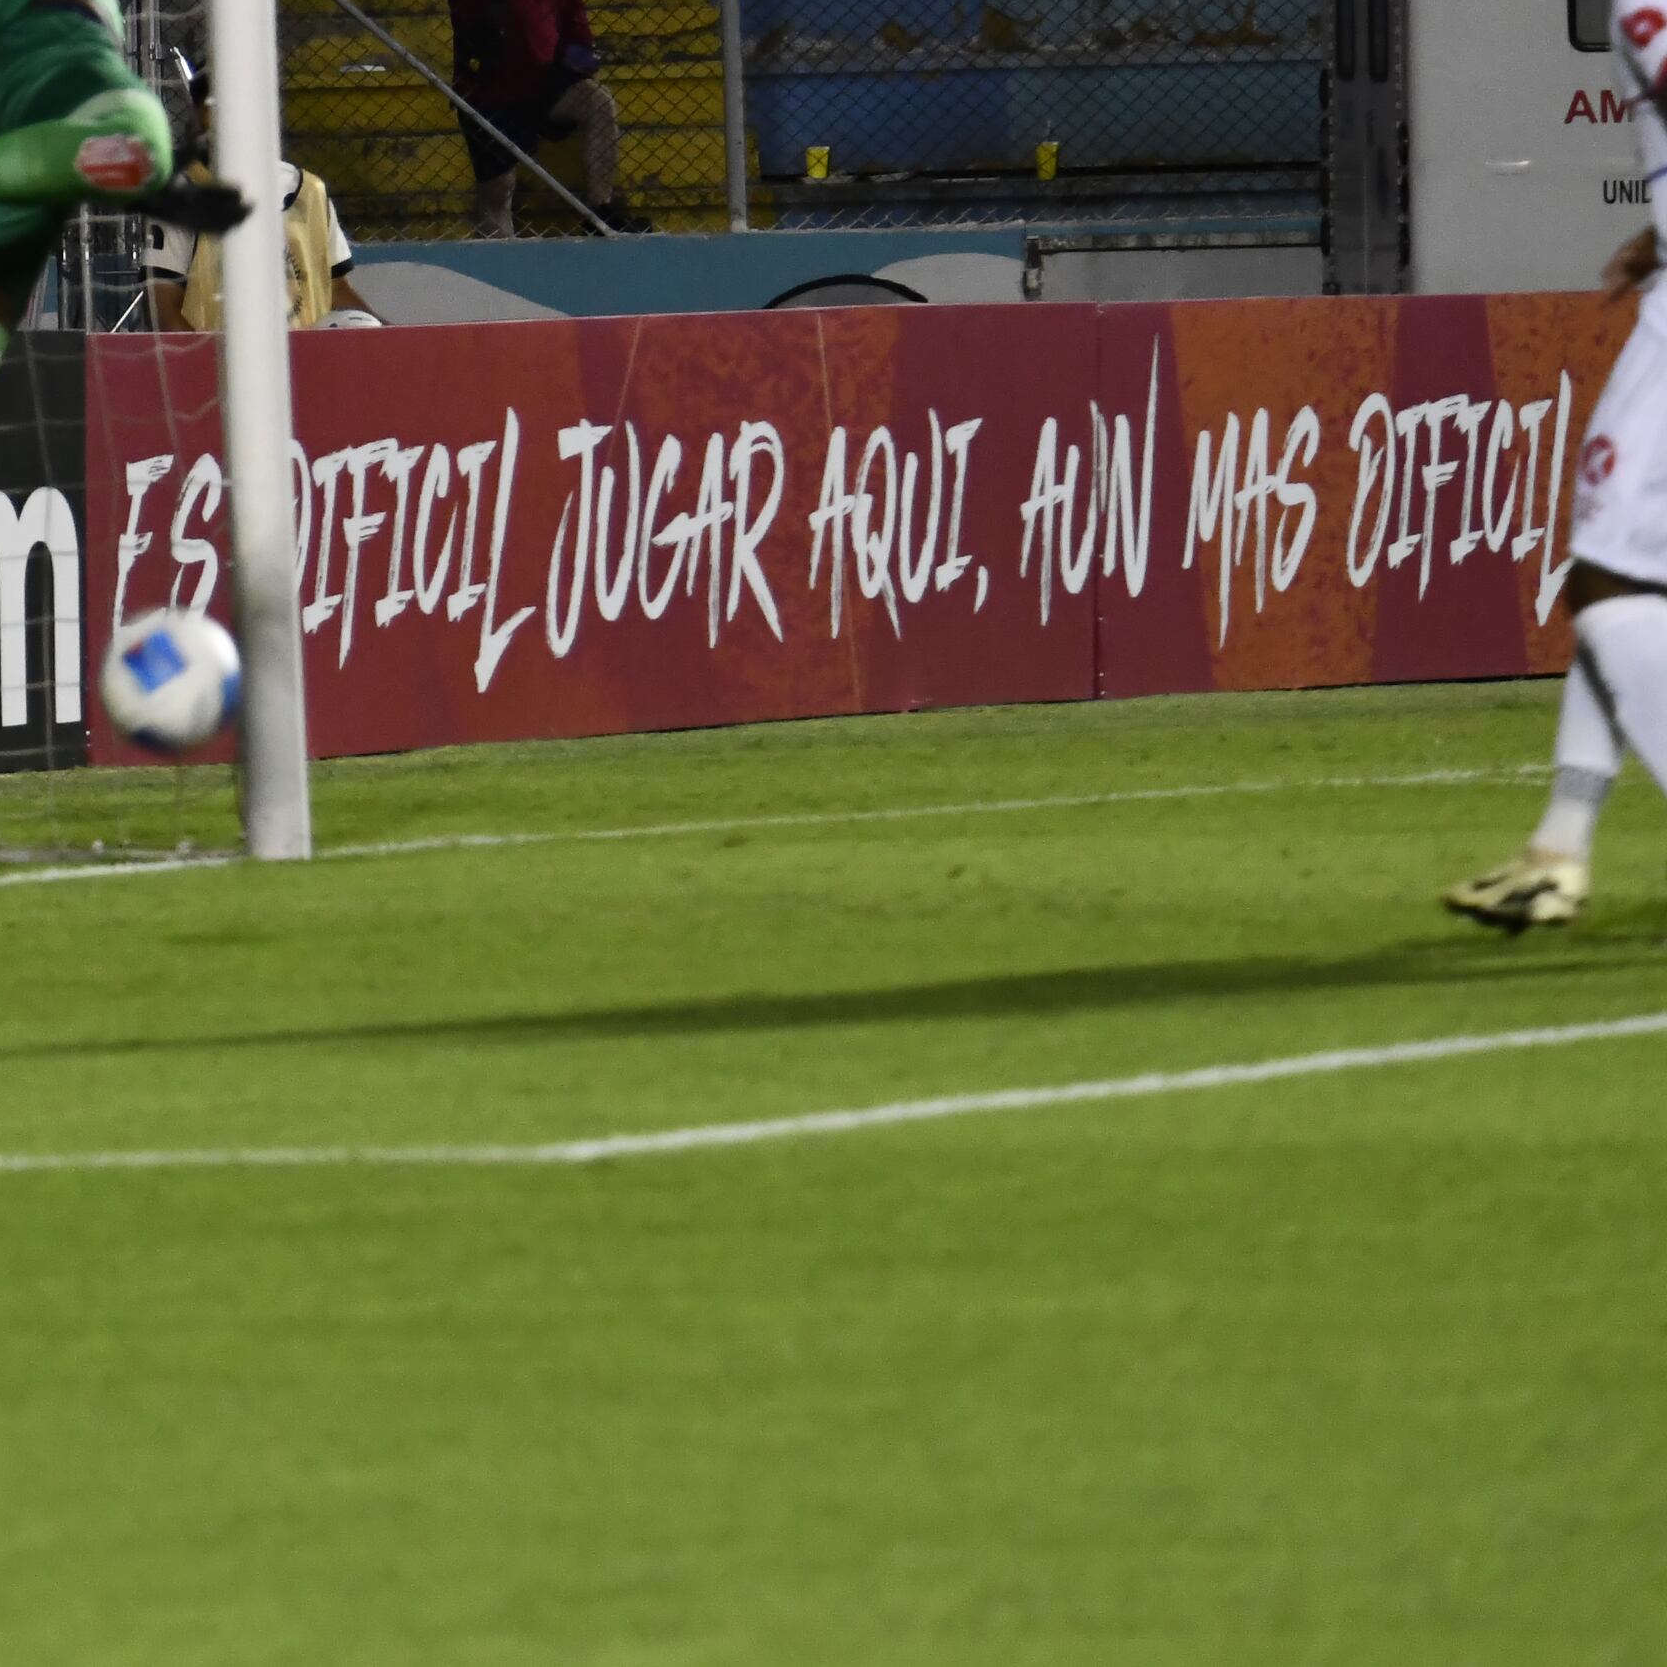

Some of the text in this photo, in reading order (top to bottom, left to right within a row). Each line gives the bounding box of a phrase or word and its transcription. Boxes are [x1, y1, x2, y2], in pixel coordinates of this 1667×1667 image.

[545, 417, 785, 660] JUGAR
[1019, 334, 1160, 627] AUN
[1181, 404, 1321, 652] MAS
[1346, 368, 1574, 627] DIFICIL
